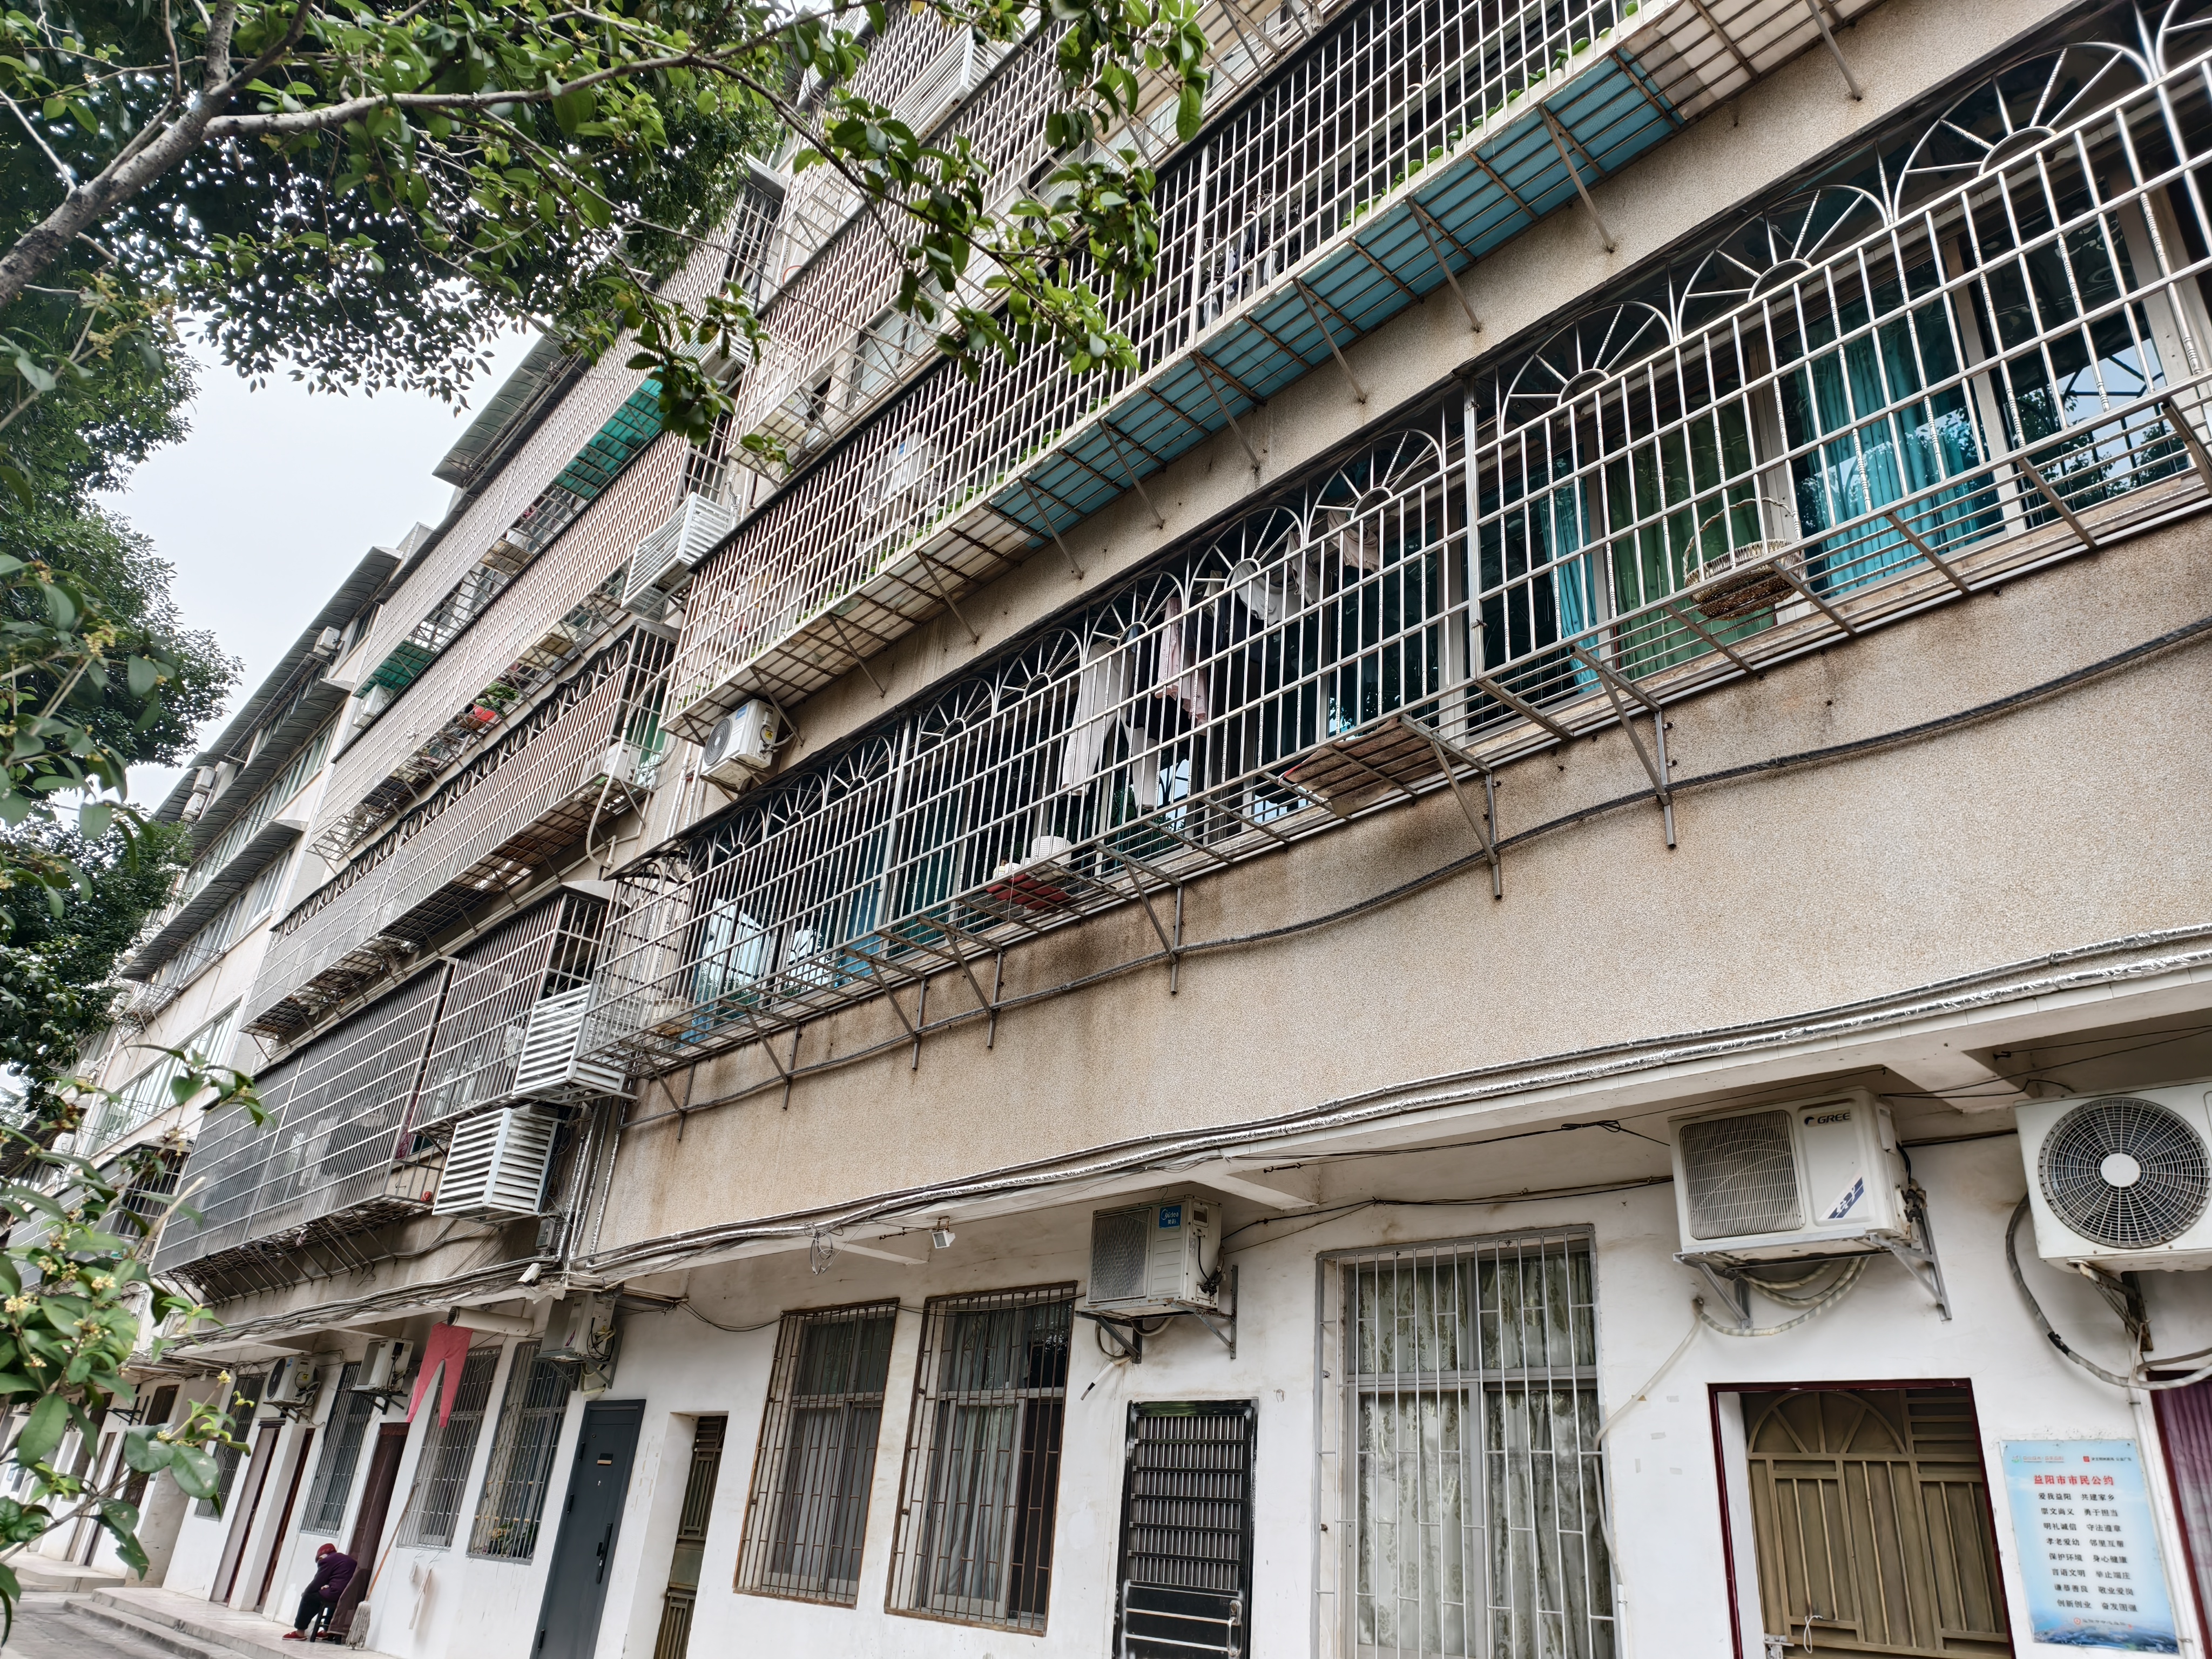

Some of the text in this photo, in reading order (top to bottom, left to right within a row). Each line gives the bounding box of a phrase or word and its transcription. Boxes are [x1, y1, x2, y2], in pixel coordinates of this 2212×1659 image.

[1817, 1112, 1851, 1124] GREE
[1161, 1209, 1179, 1220] Midea
[2033, 1474, 2114, 1486] 益阳市市民公约
[2038, 1492, 2114, 1501] 爱我益阳 共建家乡
[2084, 1508, 2118, 1516] 勇于担当
[2043, 1522, 2077, 1530] 明礼诚信
[2046, 1537, 2080, 1546] 孝老爱幼
[2049, 1553, 2128, 1563] 保护环境 身心健康
[2052, 1568, 2086, 1577] 言语文明
[2098, 1586, 2134, 1596] 敬业爱岗
[2057, 1599, 2092, 1609] 创新创业
